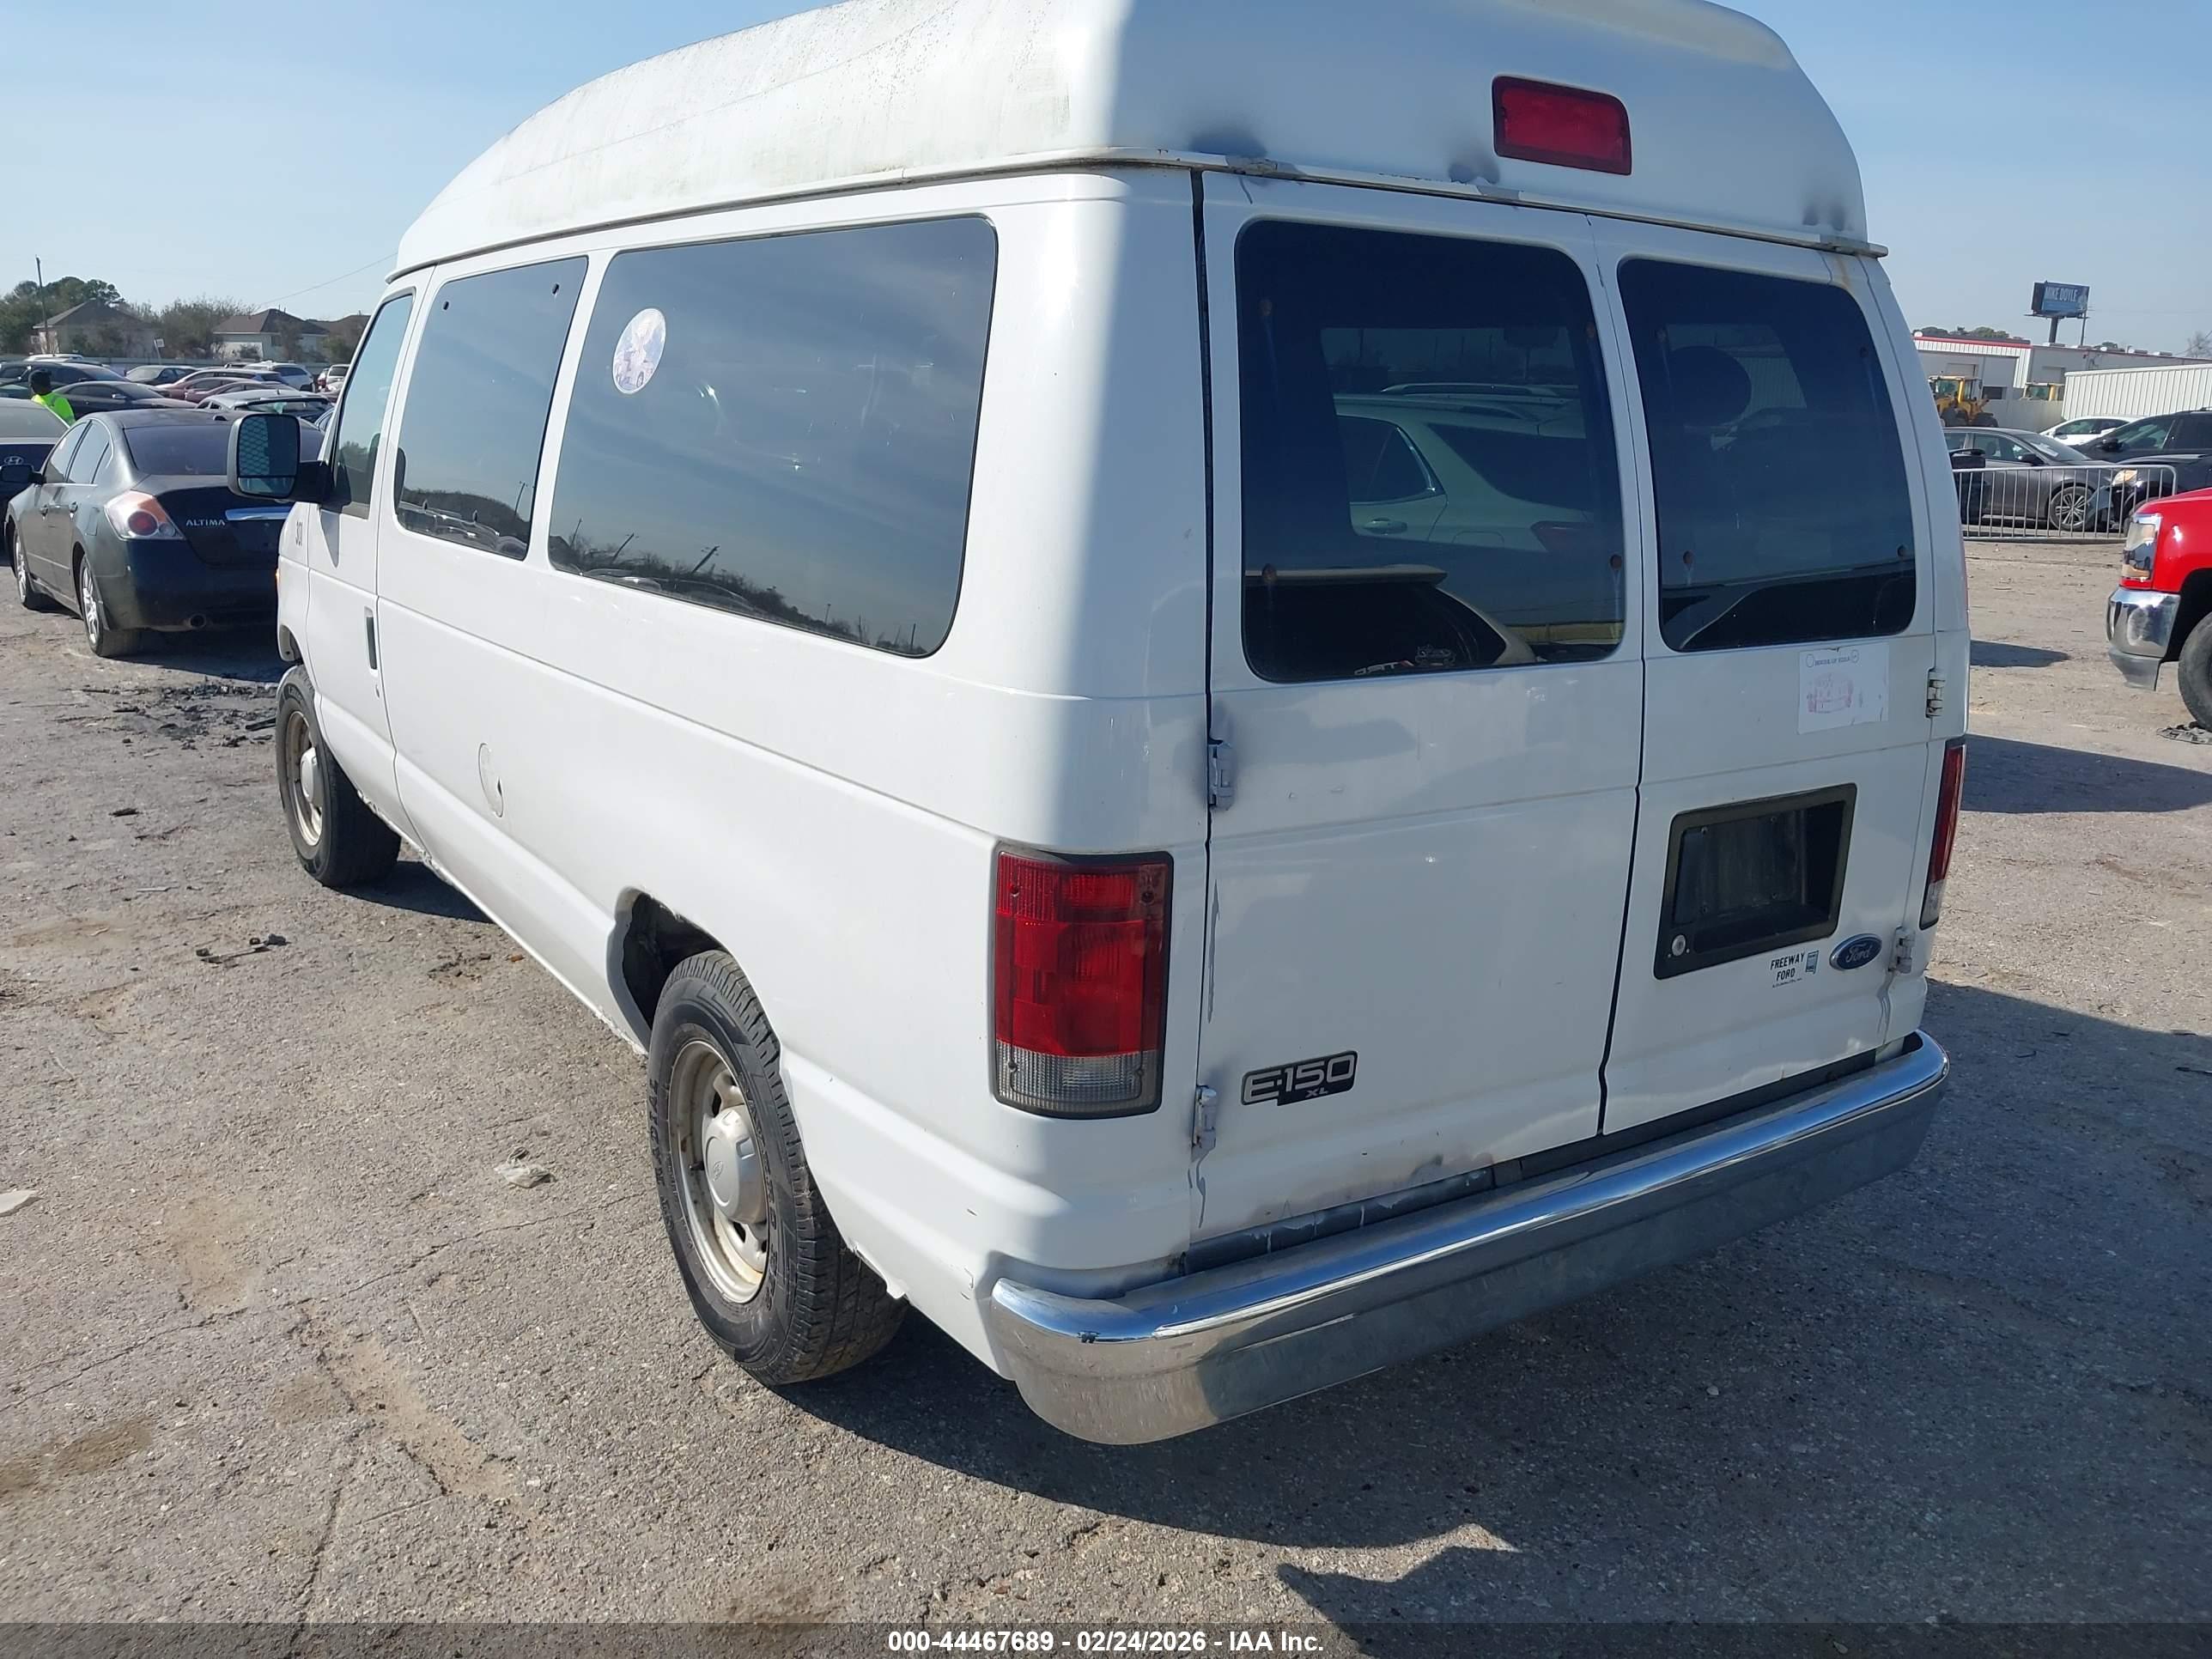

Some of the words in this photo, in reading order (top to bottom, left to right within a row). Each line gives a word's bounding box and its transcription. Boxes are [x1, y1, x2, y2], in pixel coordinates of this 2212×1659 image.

[1770, 951, 1805, 970] FREEWAY
[1846, 944, 1872, 963] Ford
[1776, 967, 1796, 981] FORD
[1305, 1087, 1328, 1098] XL
[649, 1079, 665, 1187] RADIAL
